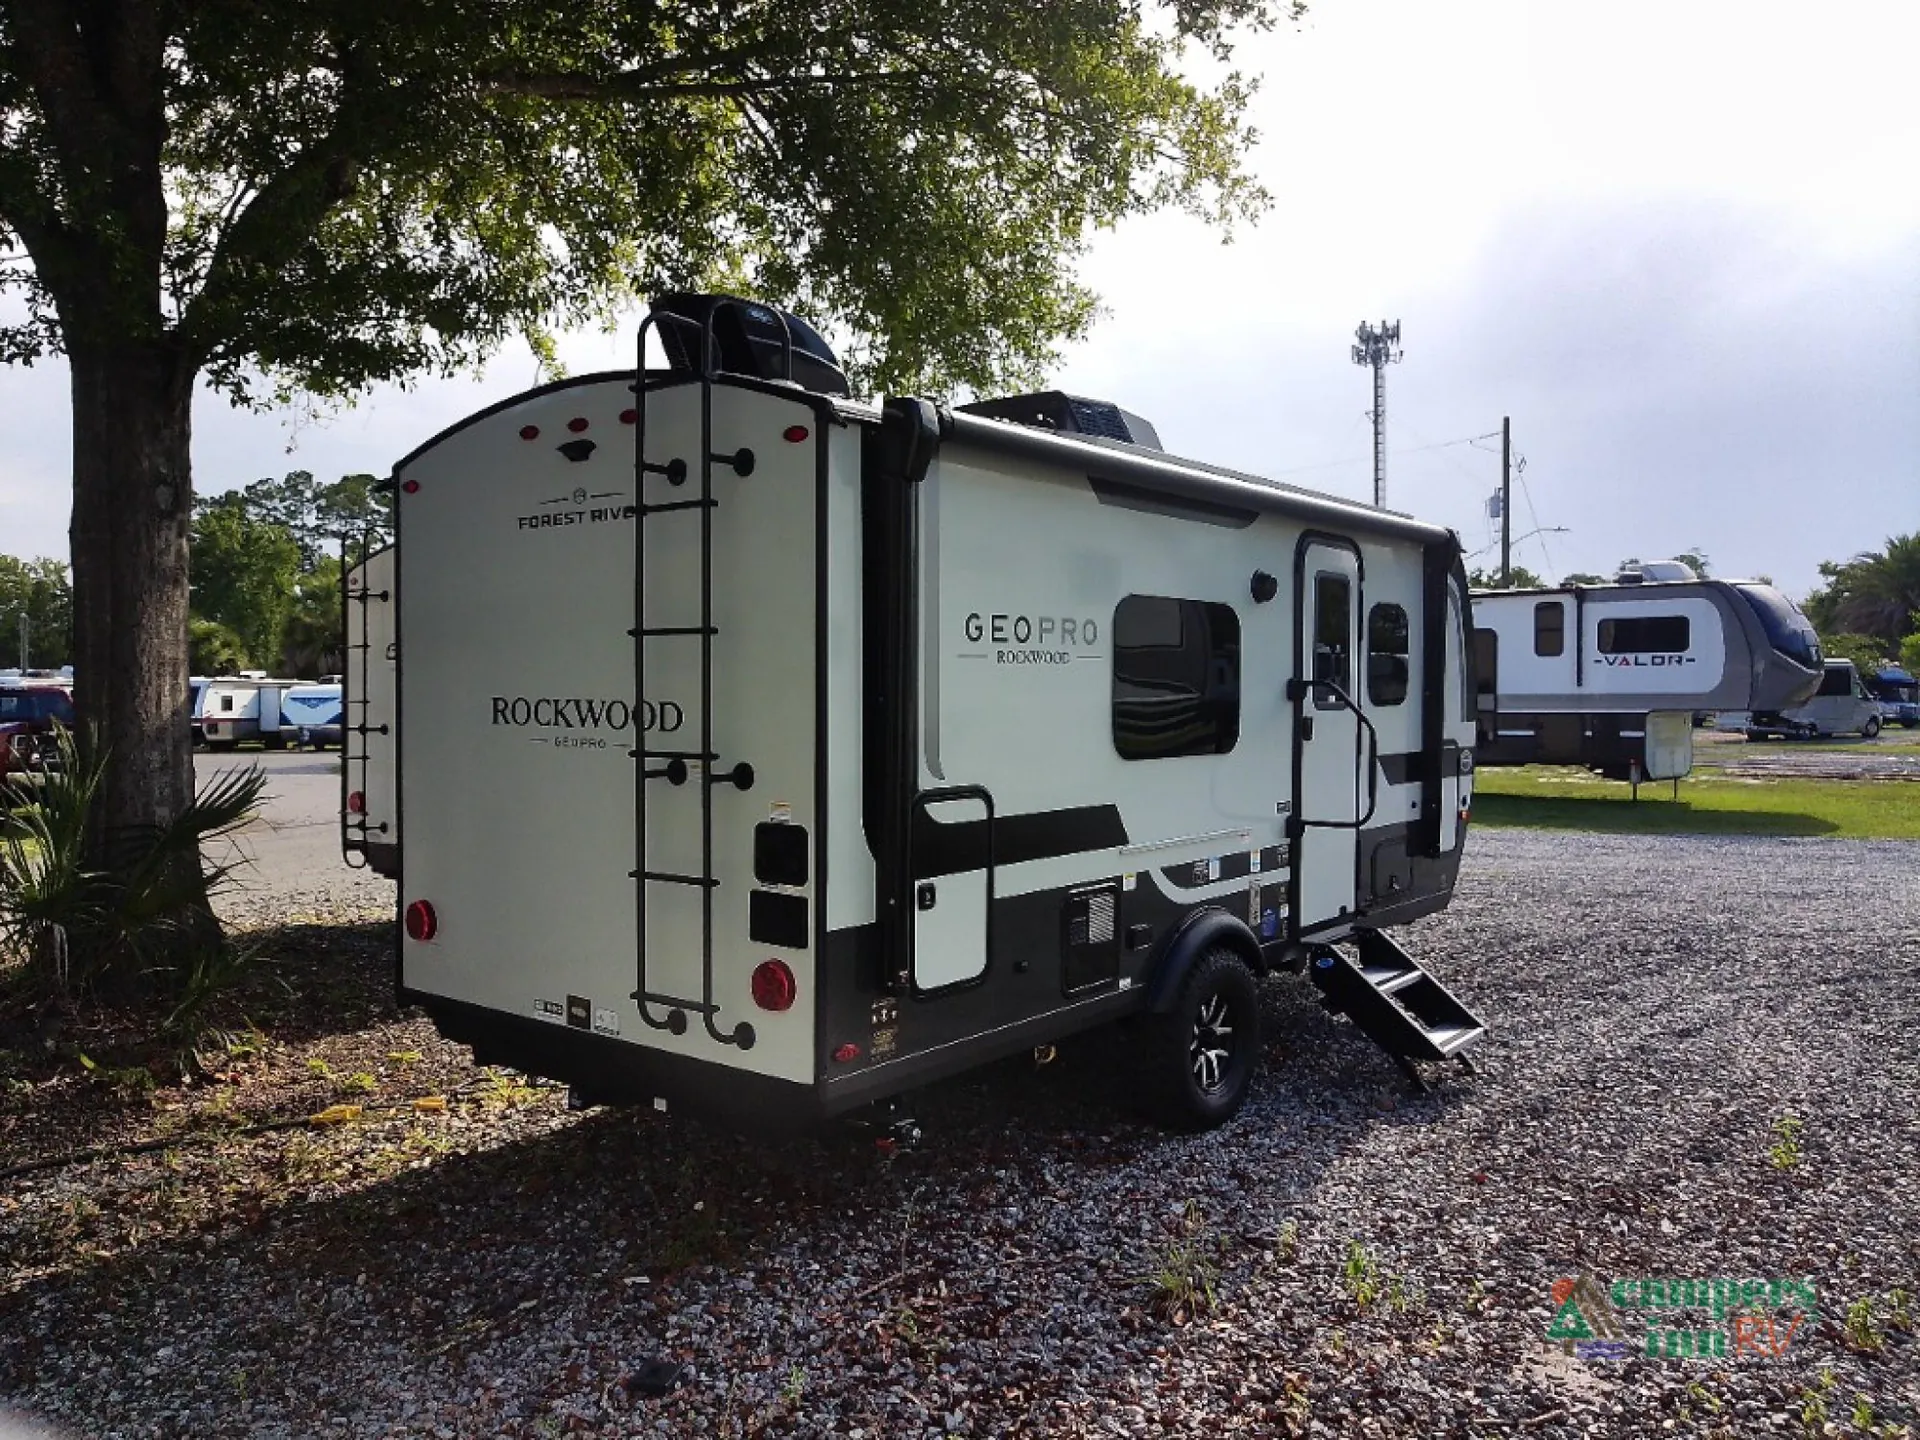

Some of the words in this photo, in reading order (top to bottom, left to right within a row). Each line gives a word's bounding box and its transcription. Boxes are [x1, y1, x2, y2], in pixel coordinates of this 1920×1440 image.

[517, 511, 586, 529] FOREST
[590, 505, 641, 521] RIVE
[965, 612, 1098, 646] GEOPRO
[996, 650, 1071, 665] ROCKWOOD
[1604, 654, 1683, 666] VALOR
[491, 696, 685, 732] ROCKWOOD
[554, 736, 606, 749] GEOPRO
